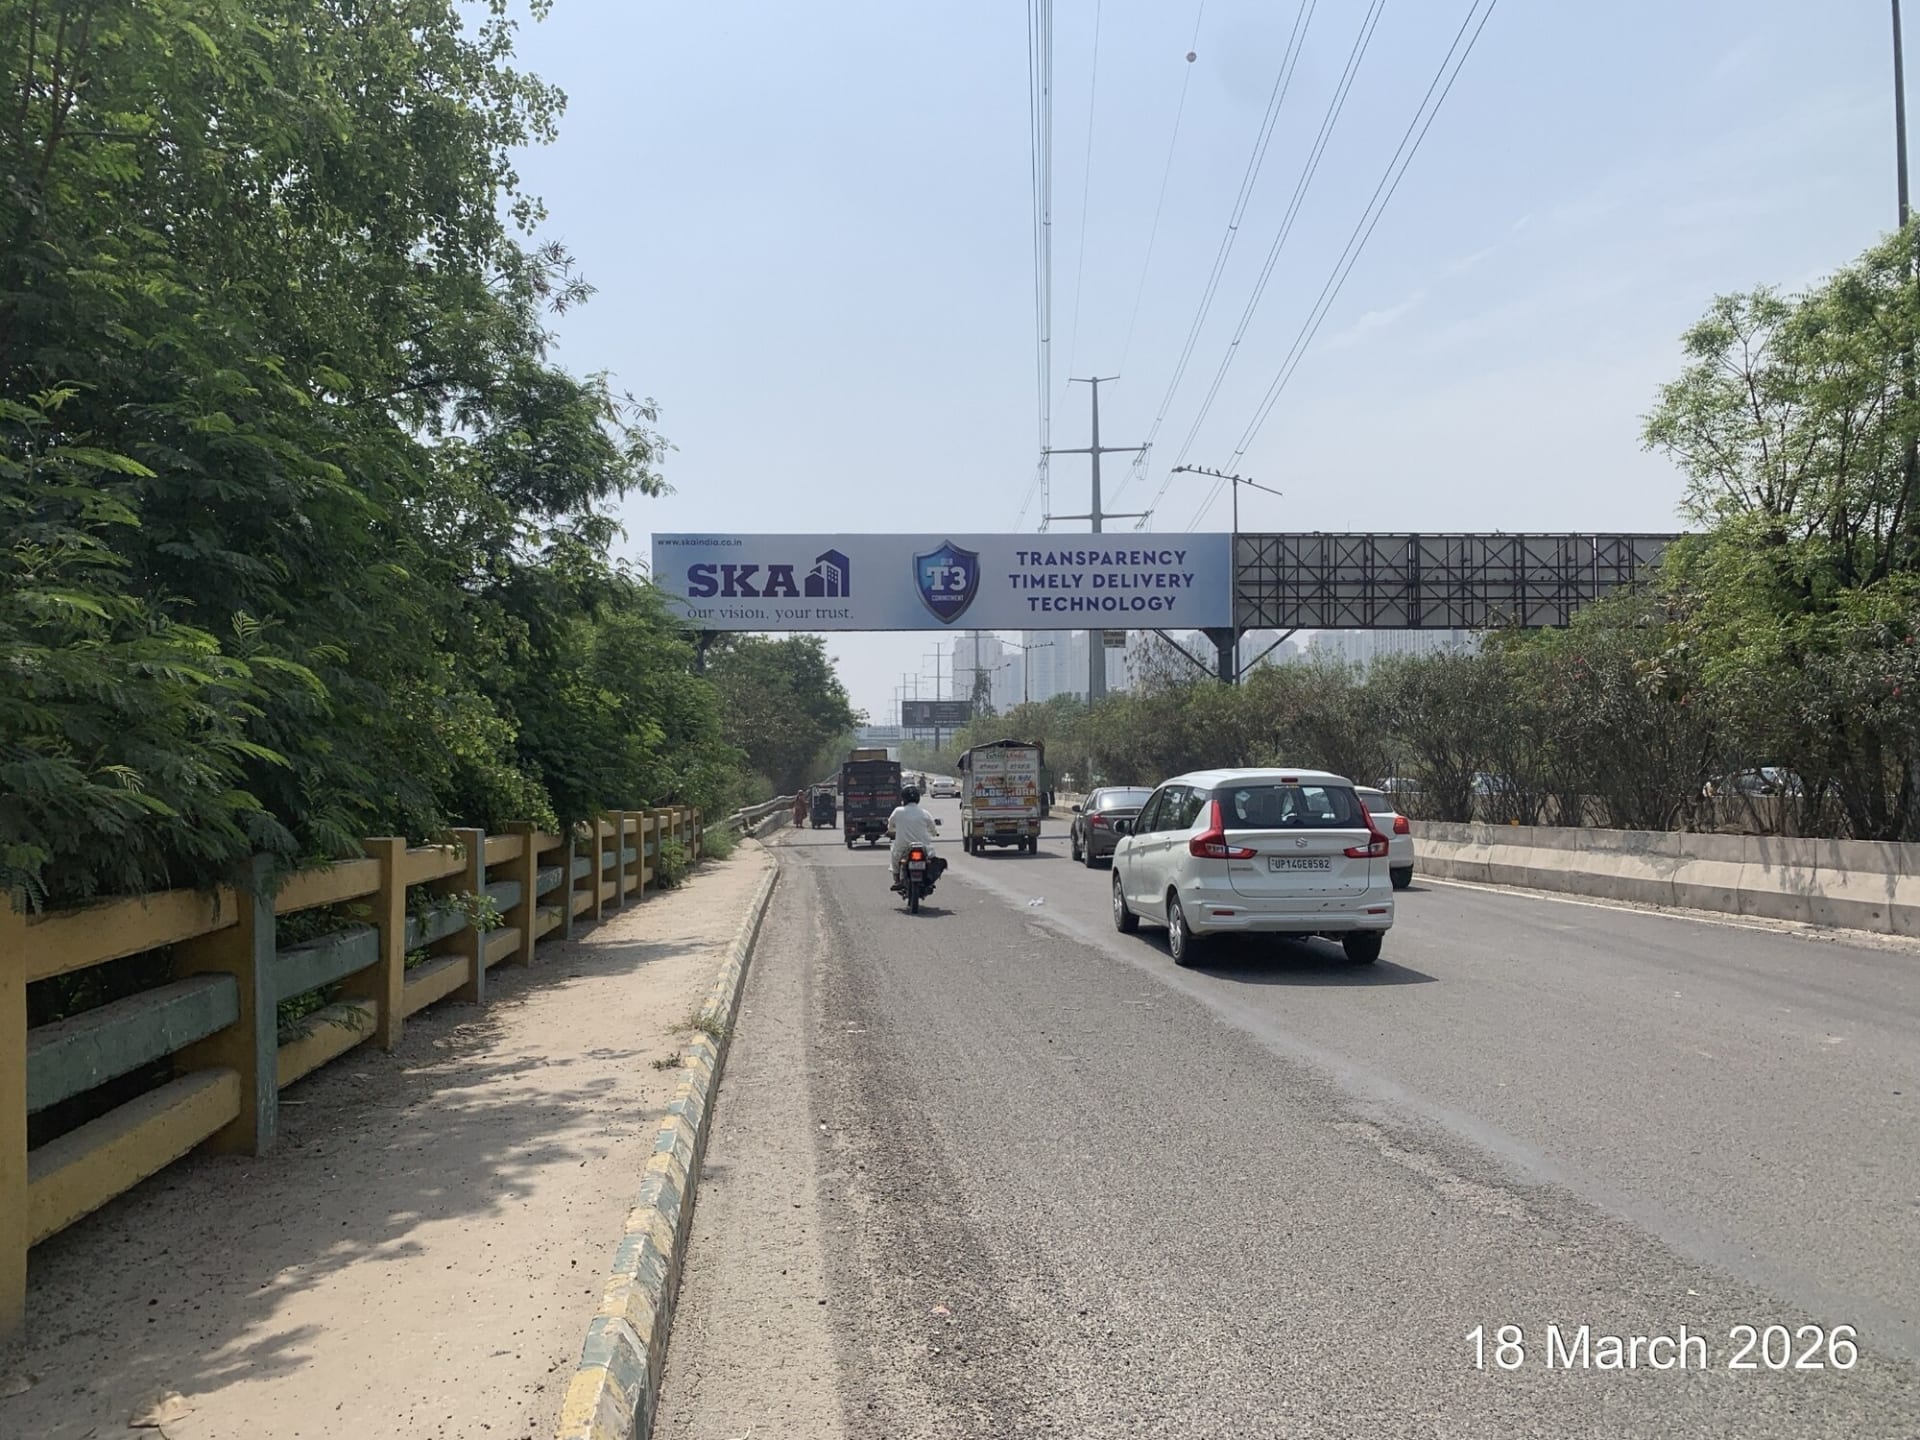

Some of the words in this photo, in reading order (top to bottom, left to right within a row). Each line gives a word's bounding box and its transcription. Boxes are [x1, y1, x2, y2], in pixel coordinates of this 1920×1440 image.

[657, 538, 743, 547] www.skaindia.co.in
[1015, 550, 1187, 566] TRANSPARENCY
[687, 563, 800, 598] SKA
[926, 566, 966, 591] T3
[1008, 573, 1084, 589] TIMELY
[1092, 573, 1195, 589] DELIVERY
[1027, 596, 1177, 612] TECHNOLOGY
[687, 606, 715, 620] our
[775, 606, 812, 623] your
[815, 606, 854, 620] trust.
